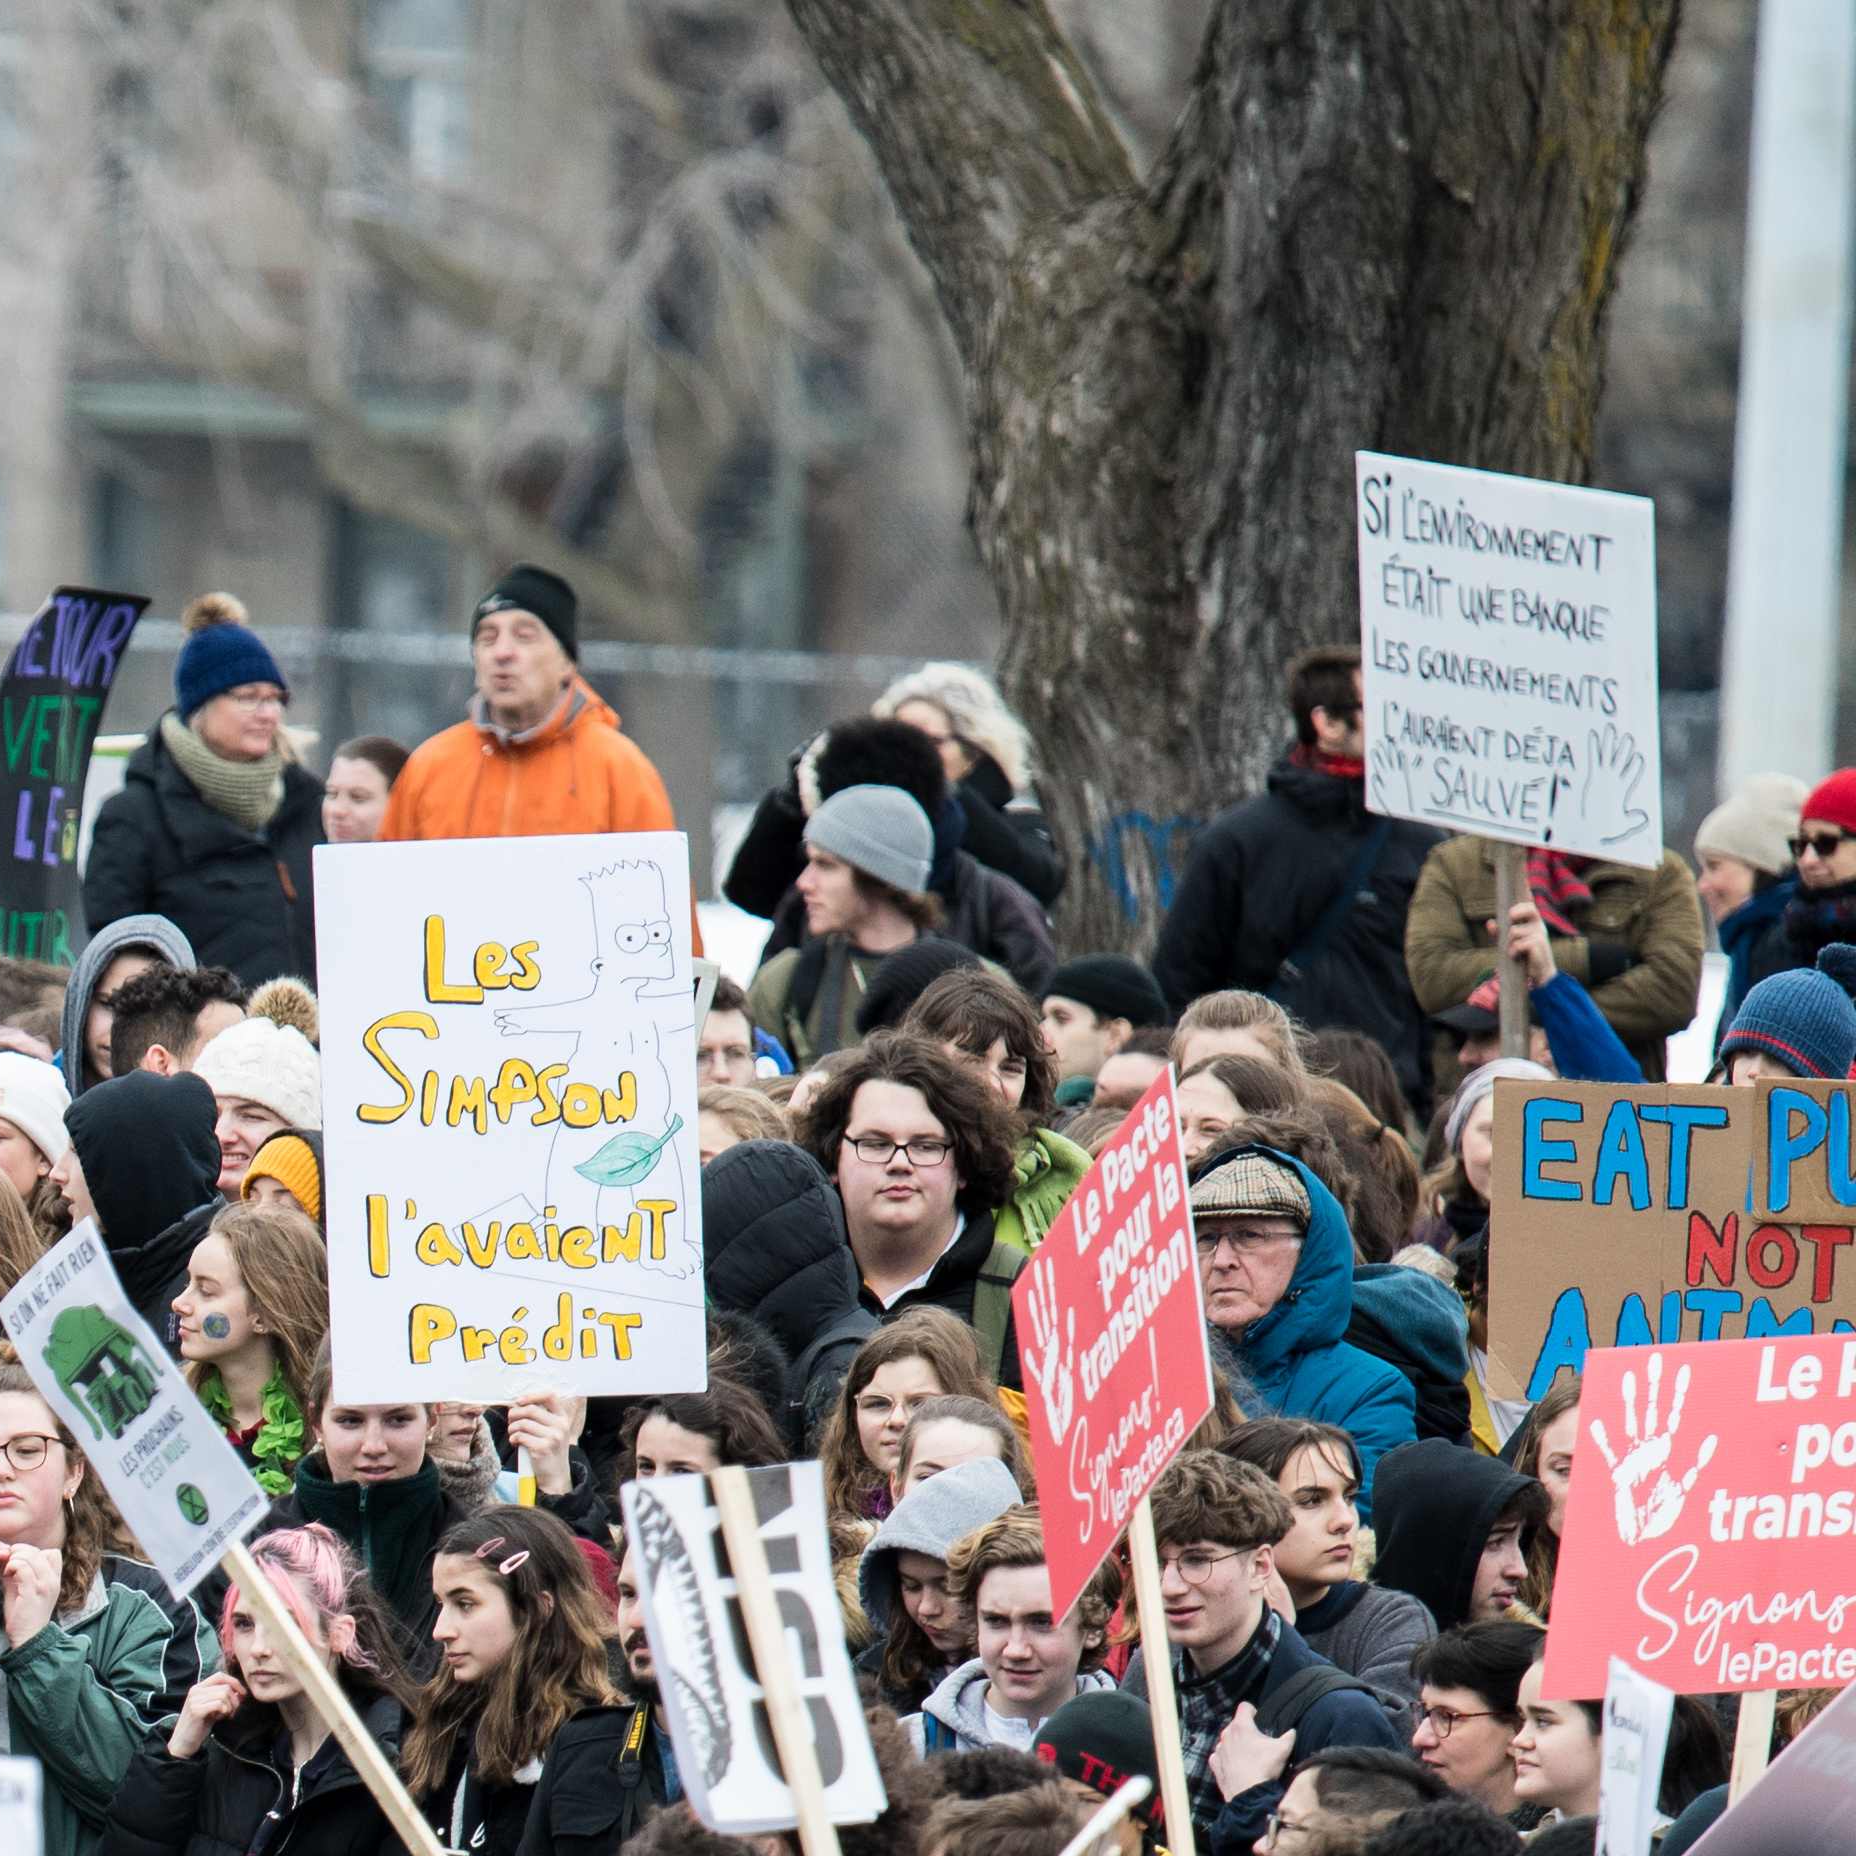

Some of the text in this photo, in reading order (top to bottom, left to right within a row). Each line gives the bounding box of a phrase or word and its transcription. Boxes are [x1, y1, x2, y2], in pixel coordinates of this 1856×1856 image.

[1458, 584, 1507, 630] UNE
[1511, 588, 1609, 645] BANQUE
[1372, 626, 1618, 717] LES GOUVERNEMENTS
[424, 914, 542, 1005] Les
[1070, 1094, 1170, 1256] Le Pacte
[1522, 1097, 1730, 1212] EAT
[41, 1260, 75, 1298] FAIT
[64, 1234, 100, 1275] RIEN
[1096, 1160, 1181, 1301] pour la
[1685, 1210, 1855, 1304] NOT
[1078, 1229, 1189, 1401] transition
[1756, 1346, 1824, 1402] Le
[1109, 1407, 1186, 1529] lePacte.ca
